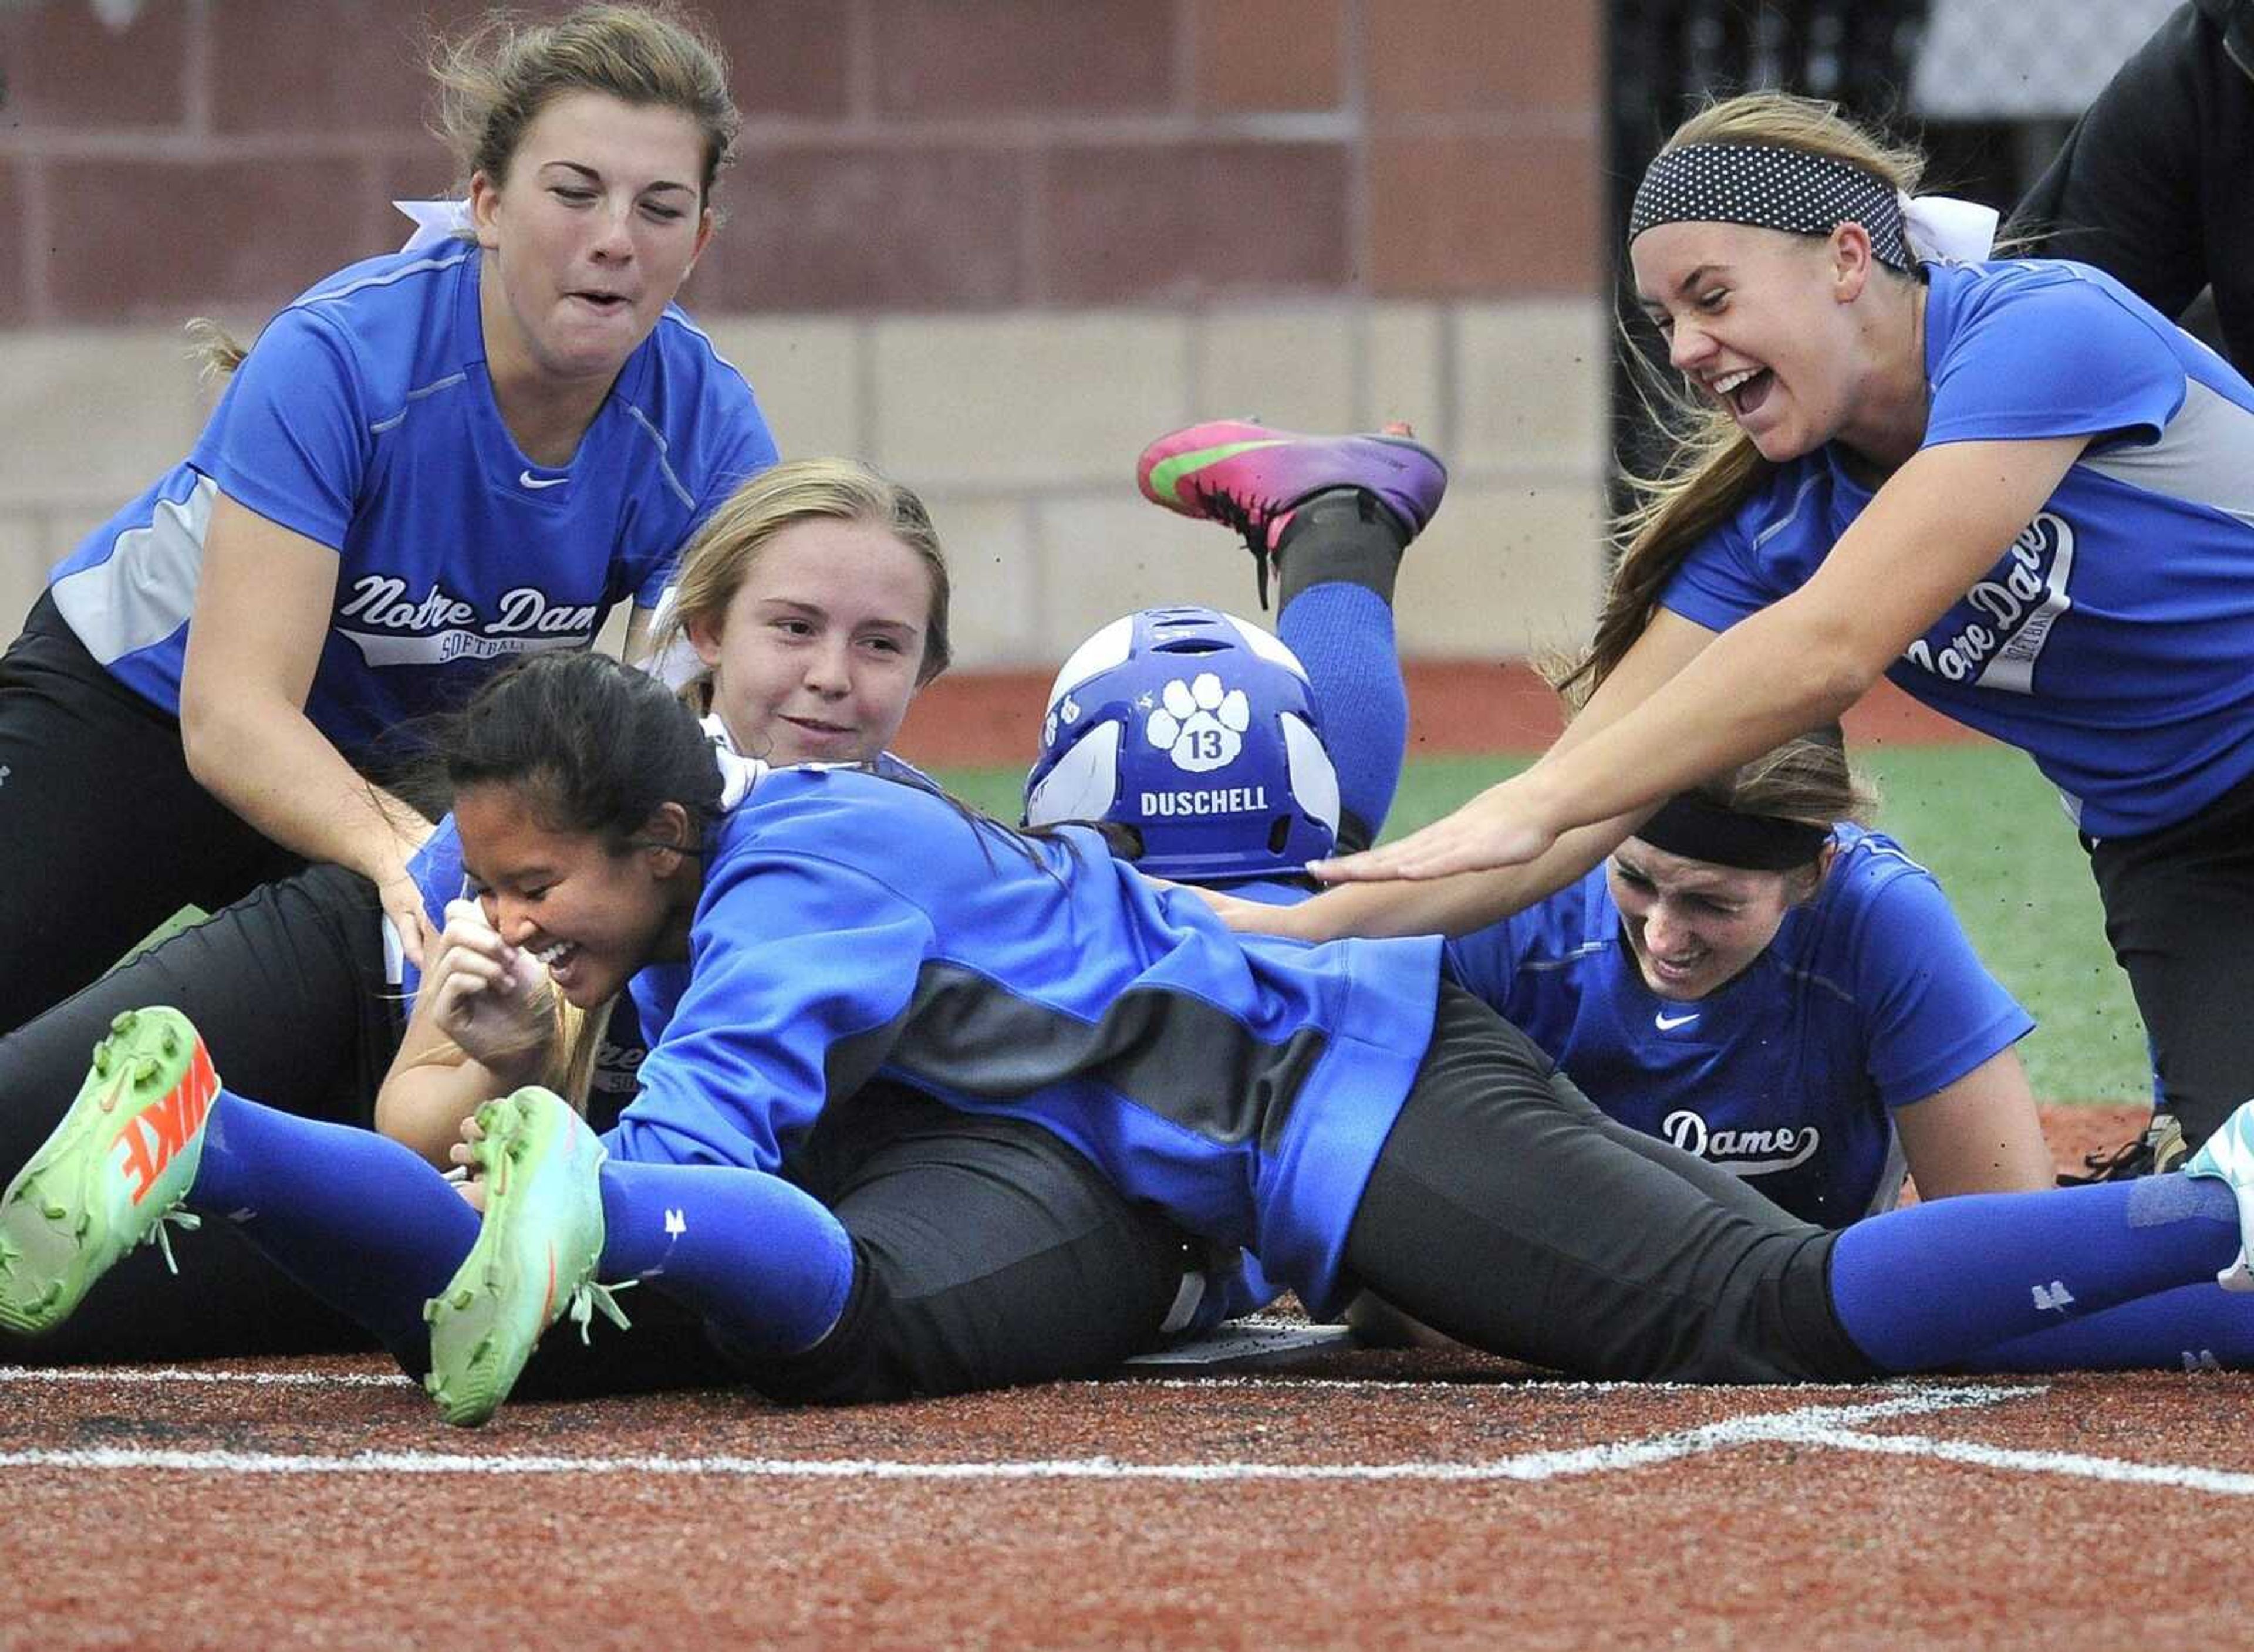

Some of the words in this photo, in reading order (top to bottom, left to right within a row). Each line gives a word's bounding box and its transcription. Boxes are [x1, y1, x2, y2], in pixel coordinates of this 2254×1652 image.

[340, 575, 475, 629] Notre
[485, 588, 596, 634] Dam
[1186, 729, 1222, 759] 13
[1141, 786, 1268, 816] DUSCHELL
[1662, 1110, 1811, 1157] Dame
